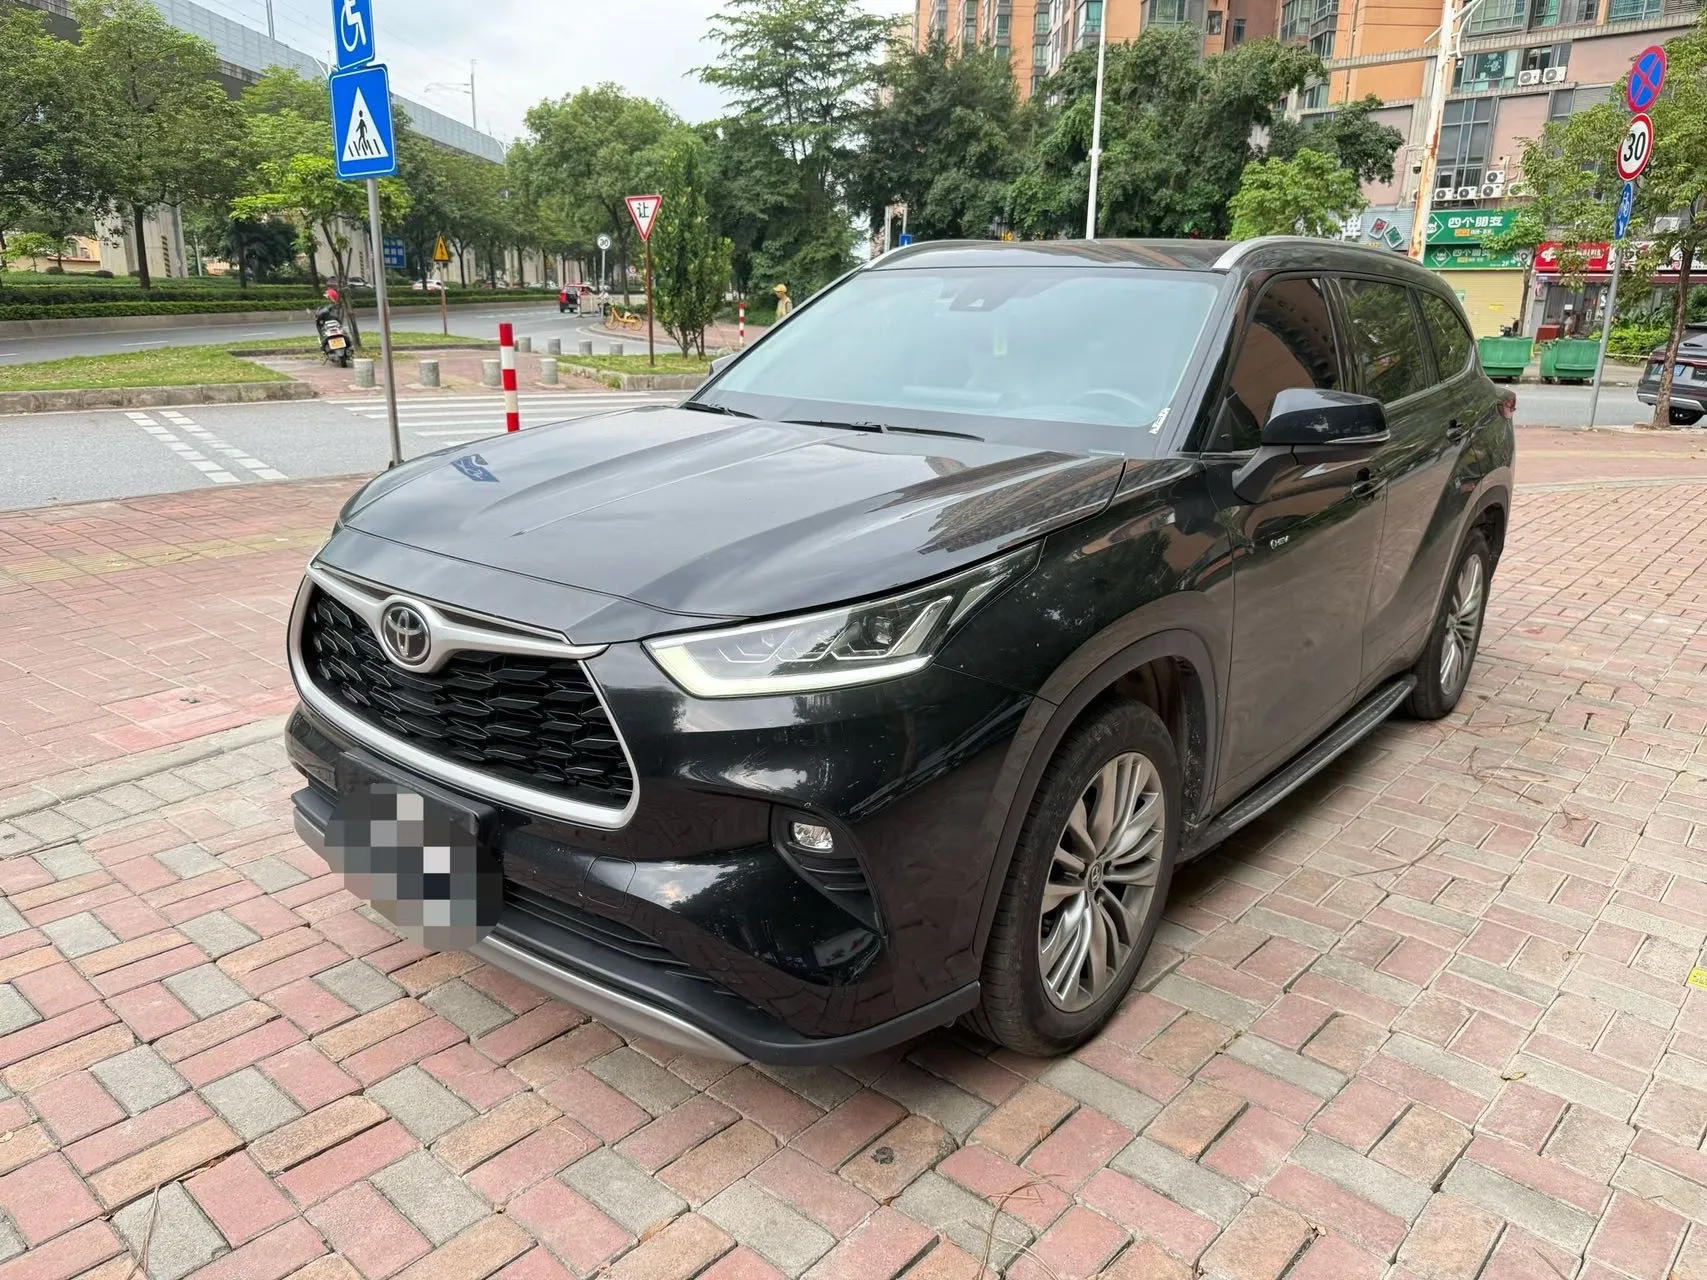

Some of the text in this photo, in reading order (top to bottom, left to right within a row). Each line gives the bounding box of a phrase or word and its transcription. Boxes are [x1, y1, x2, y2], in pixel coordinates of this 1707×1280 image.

[1623, 131, 1646, 162] 30
[637, 202, 650, 218] 让
[1448, 216, 1504, 228] 四个朋友
[600, 239, 609, 247] 30
